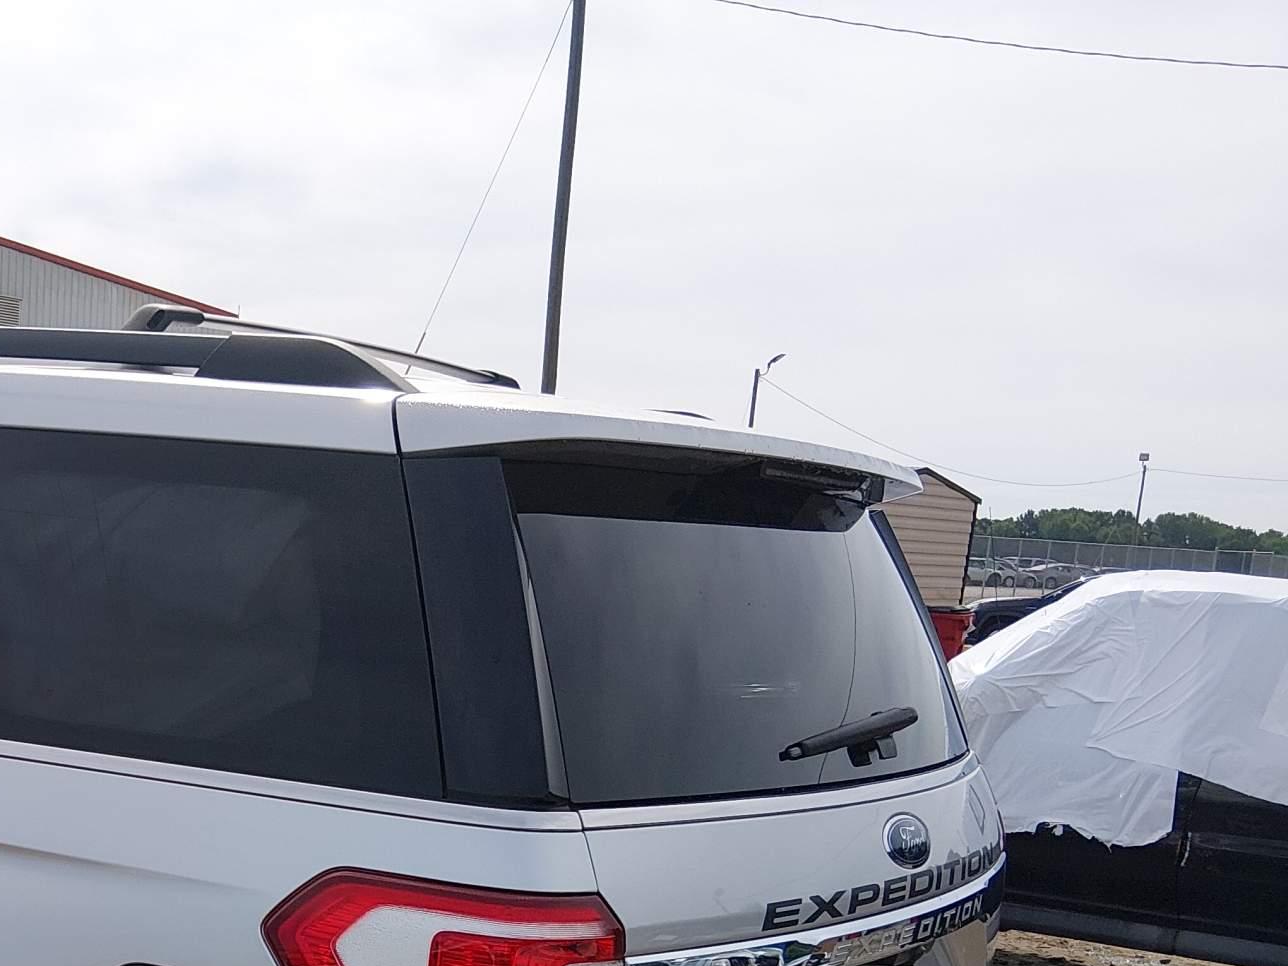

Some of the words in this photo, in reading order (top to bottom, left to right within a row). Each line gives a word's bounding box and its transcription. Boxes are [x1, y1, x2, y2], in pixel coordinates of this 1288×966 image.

[898, 825, 926, 853] Ford
[762, 842, 999, 931] EXPEDITION
[828, 893, 984, 966] EXPEDITION
